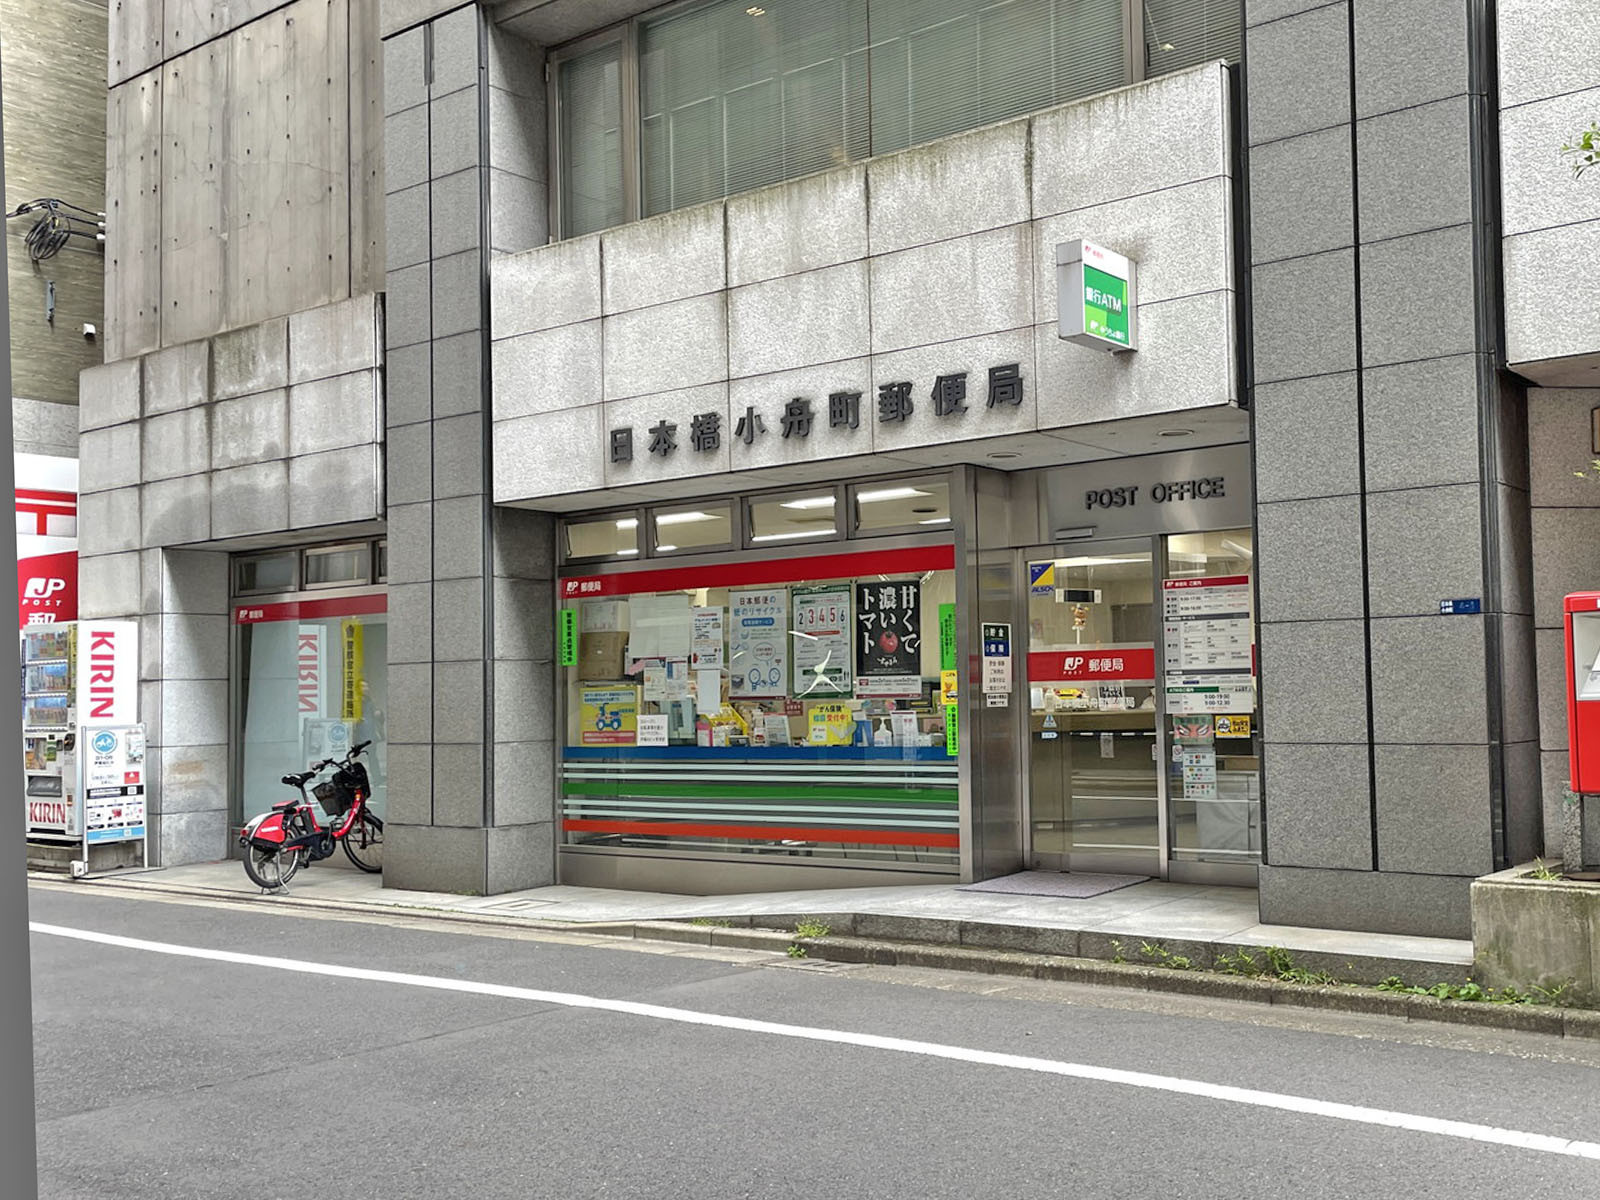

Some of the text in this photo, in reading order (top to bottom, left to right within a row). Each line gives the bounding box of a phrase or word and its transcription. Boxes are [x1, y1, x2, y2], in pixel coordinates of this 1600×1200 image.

[610, 363, 1024, 464] 日本橋小舟町郵便局
[1085, 477, 1226, 511] POST OFFICE
[22, 599, 62, 607] POST
[799, 612, 804, 625] 2
[808, 608, 814, 624] 3
[830, 607, 836, 622] 5
[859, 588, 877, 655] トマト
[879, 586, 897, 629] 濃い
[900, 585, 918, 654] 甘くて
[89, 631, 115, 718] KIRIN
[1088, 657, 1124, 672] 郵便局
[29, 803, 66, 824] KIRIN
